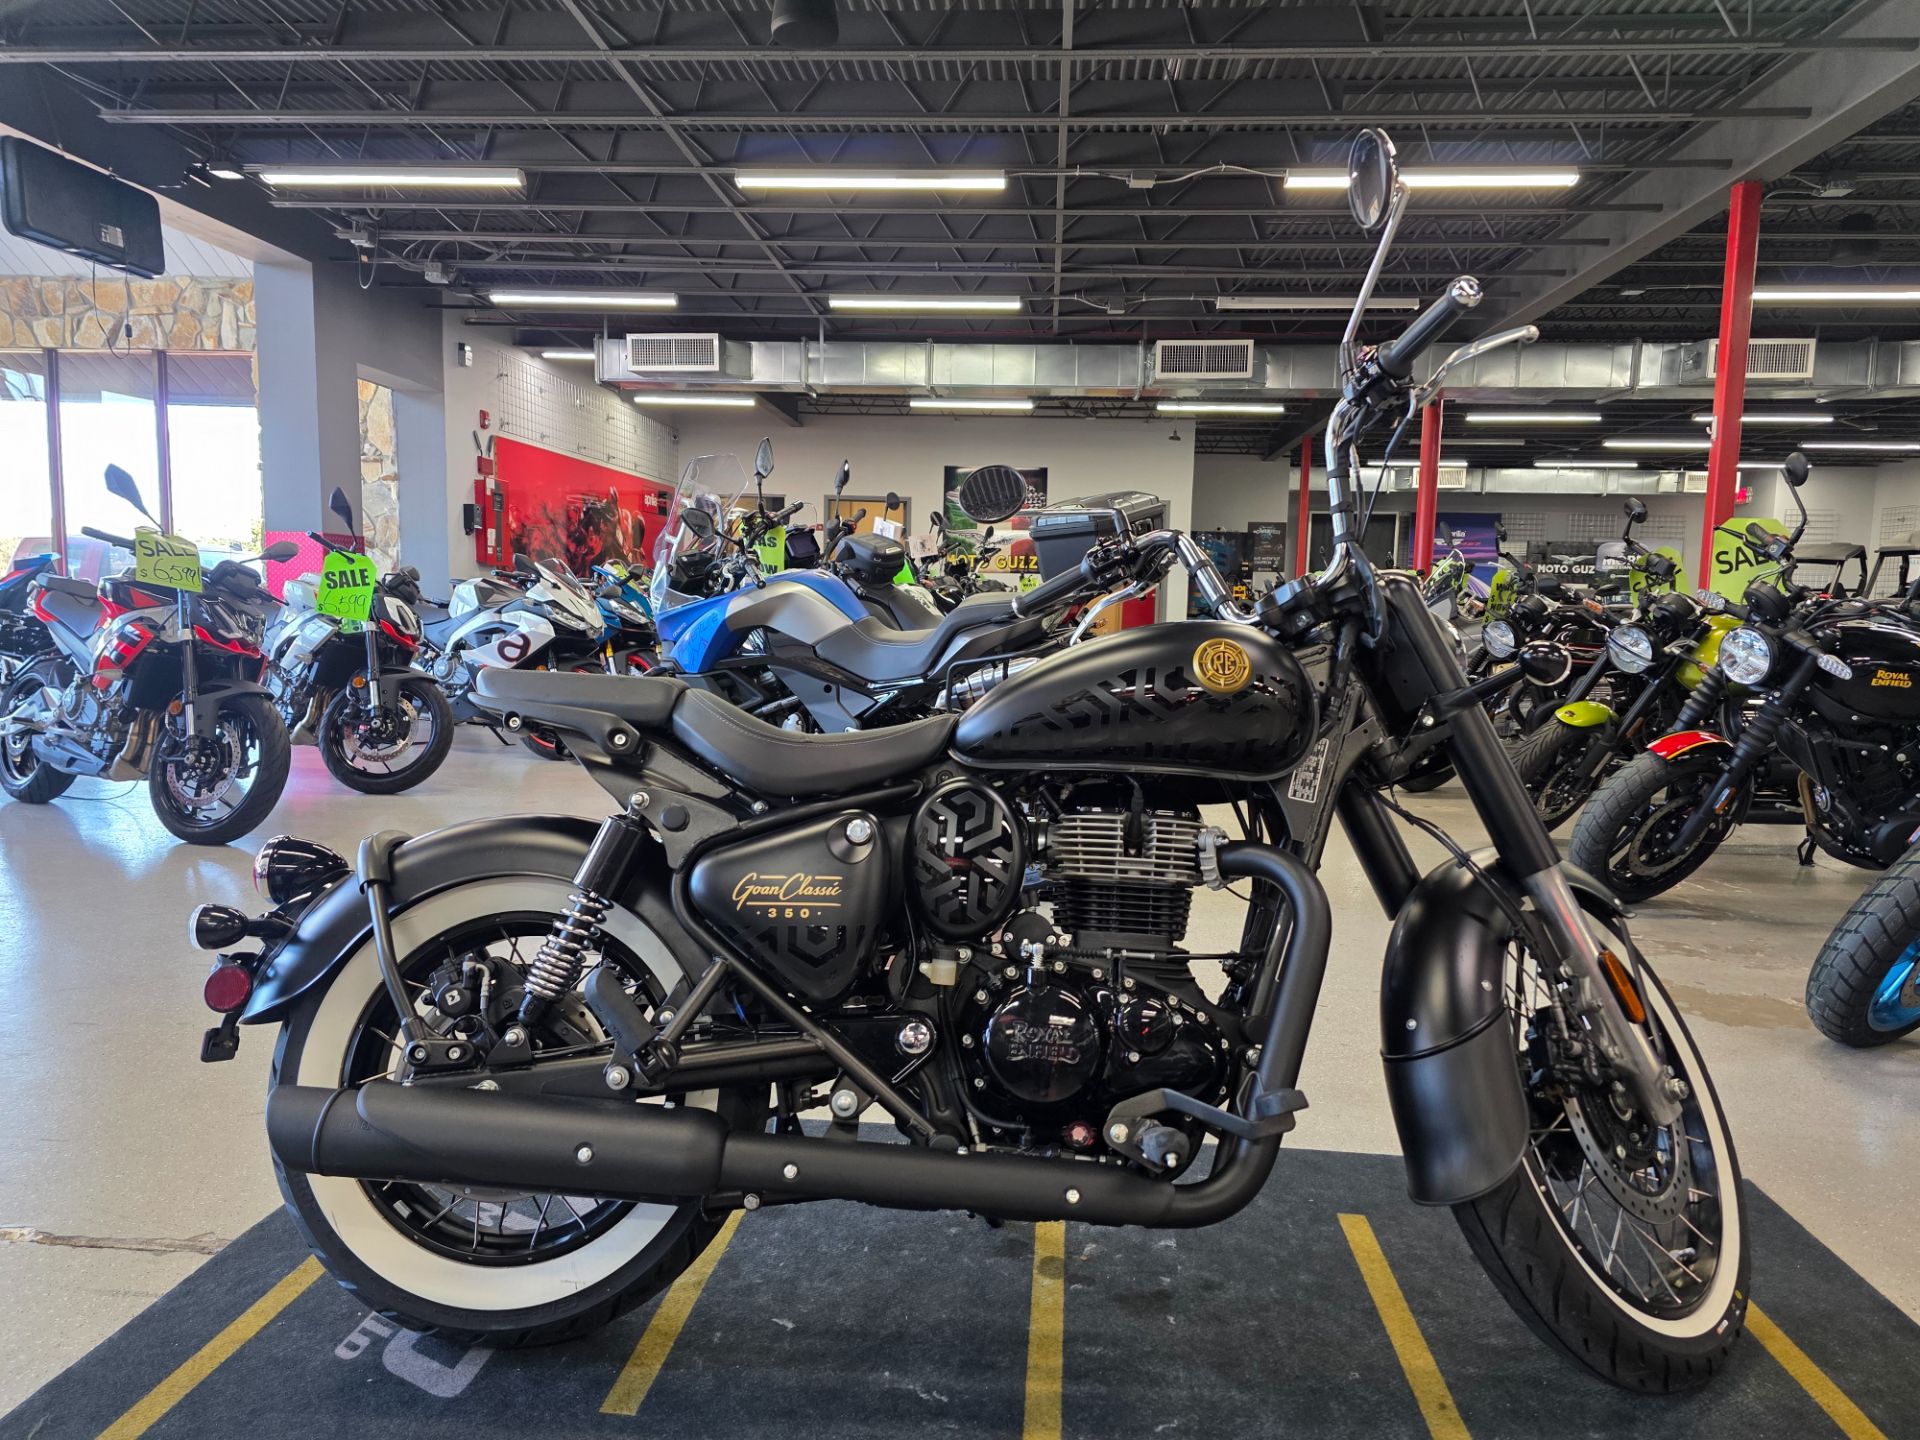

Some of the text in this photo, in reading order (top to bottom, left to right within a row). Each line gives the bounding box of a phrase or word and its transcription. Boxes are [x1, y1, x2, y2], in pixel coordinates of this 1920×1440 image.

[995, 554, 1038, 570] GUZZ
[1715, 545, 1770, 575] SAL
[1537, 563, 1569, 574] MOTO
[1571, 564, 1596, 574] GUZ
[324, 567, 371, 590] SALE
[1876, 669, 1911, 681] ROYAL
[1871, 678, 1913, 689] ENFIELD
